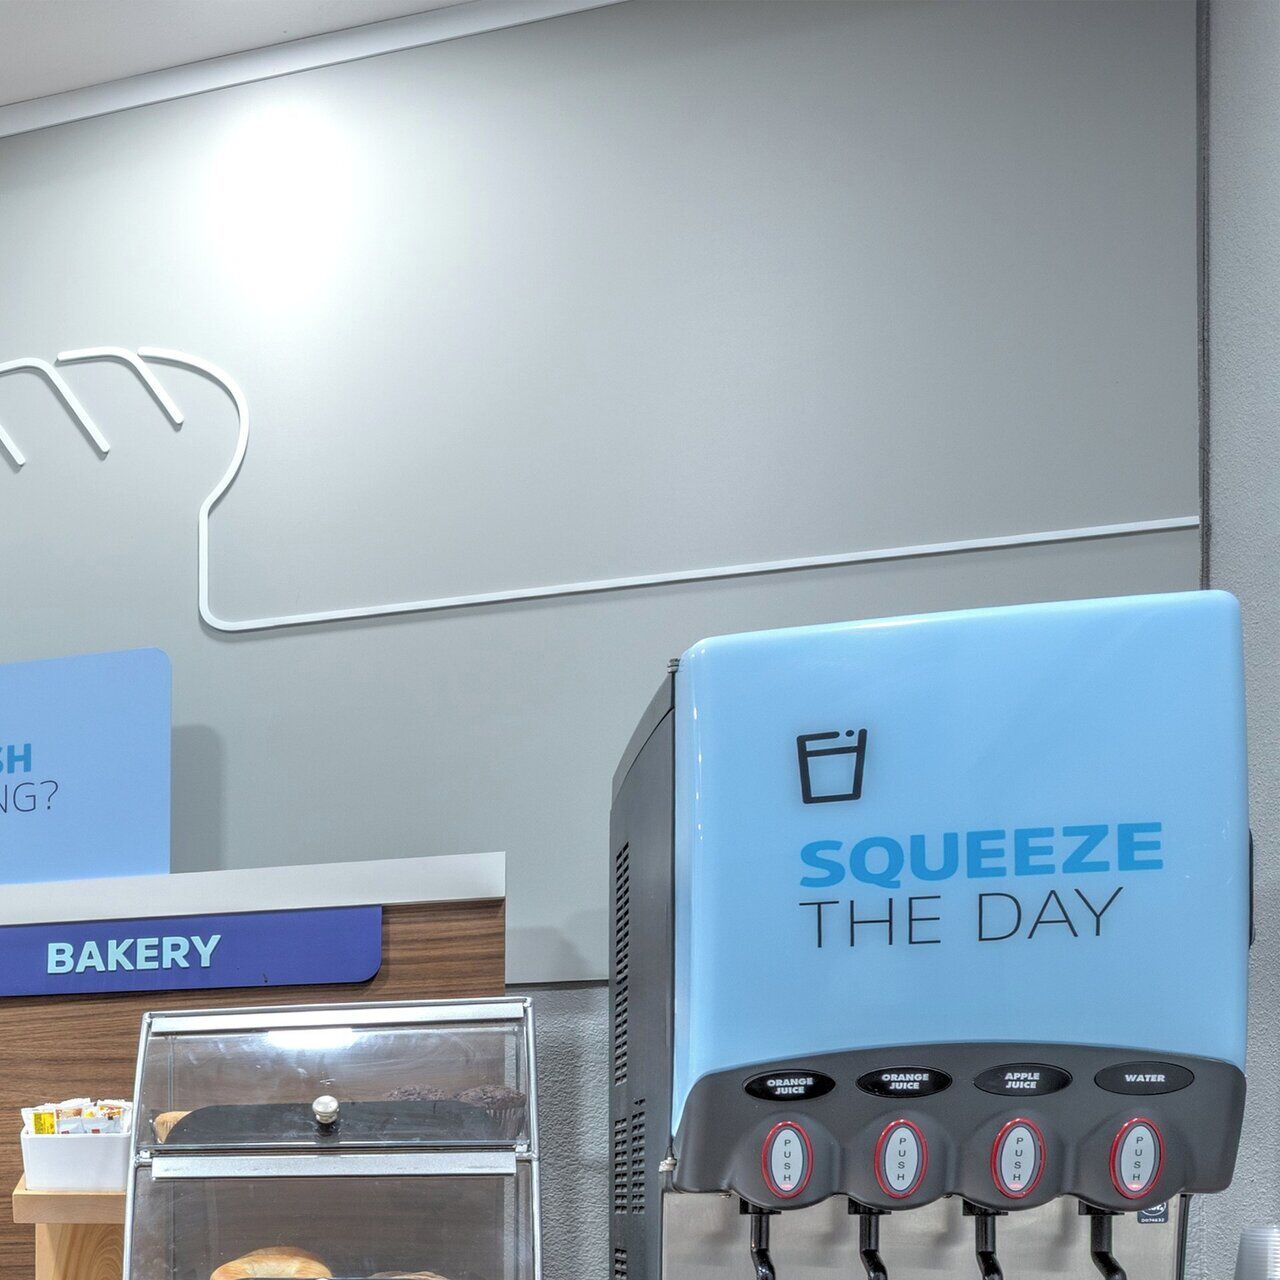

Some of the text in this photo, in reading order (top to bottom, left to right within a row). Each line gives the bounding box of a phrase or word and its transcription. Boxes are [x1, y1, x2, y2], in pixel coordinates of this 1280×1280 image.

[799, 822, 1164, 889] SQUEEZE
[799, 887, 1123, 948] THE DAY
[47, 935, 222, 974] BAKERY
[766, 1077, 814, 1087] ORANGE
[881, 1073, 930, 1082] ORANGE
[889, 1081, 920, 1090] JUICE
[1004, 1072, 1040, 1081] APPLE
[1005, 1080, 1037, 1089] JUICE
[1124, 1074, 1166, 1083] WATER
[775, 1086, 806, 1095] JUICE
[783, 1139, 792, 1182] PUSH
[896, 1137, 907, 1182] PUSH
[1012, 1137, 1024, 1181] PUSH
[1132, 1136, 1144, 1181] PUSH
